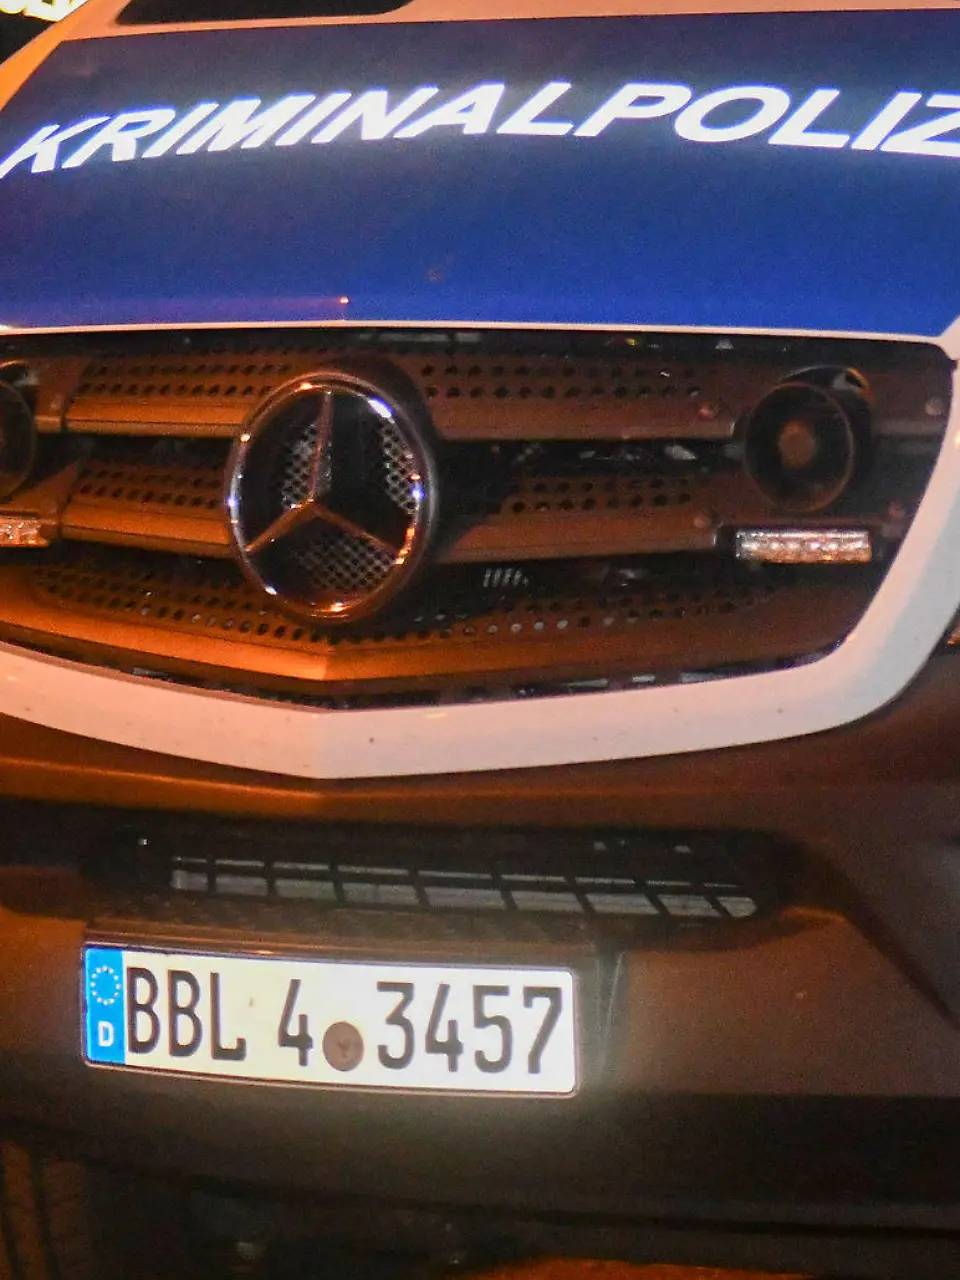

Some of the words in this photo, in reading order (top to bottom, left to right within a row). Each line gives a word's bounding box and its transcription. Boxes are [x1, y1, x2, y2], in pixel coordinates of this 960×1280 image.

[98, 1020, 114, 1047] D
[126, 966, 247, 1061] BBL
[278, 978, 314, 1067] 4
[376, 981, 562, 1075] 3457
